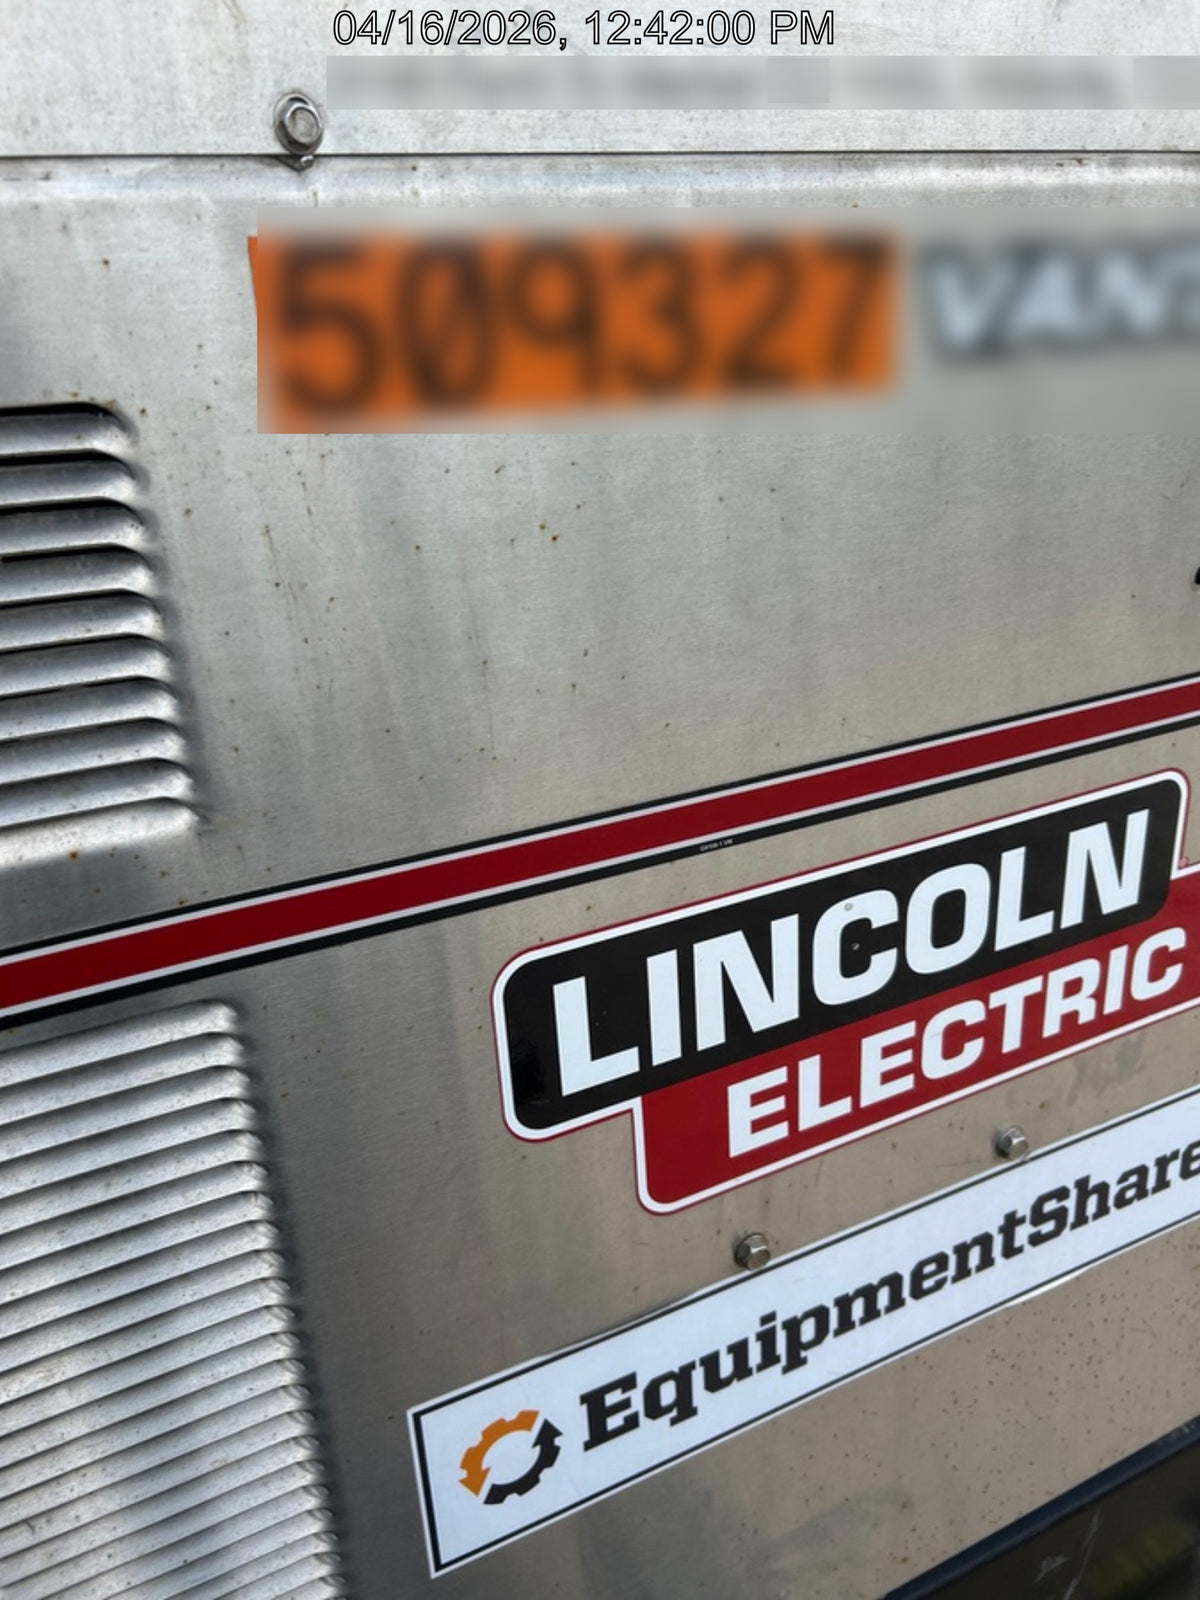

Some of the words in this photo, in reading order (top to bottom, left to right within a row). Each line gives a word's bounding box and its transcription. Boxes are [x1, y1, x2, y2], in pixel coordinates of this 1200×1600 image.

[553, 809, 1150, 1097] LINCOLN
[728, 927, 1187, 1158] ELECTRIC
[580, 1139, 1200, 1451] EquipmentShare
